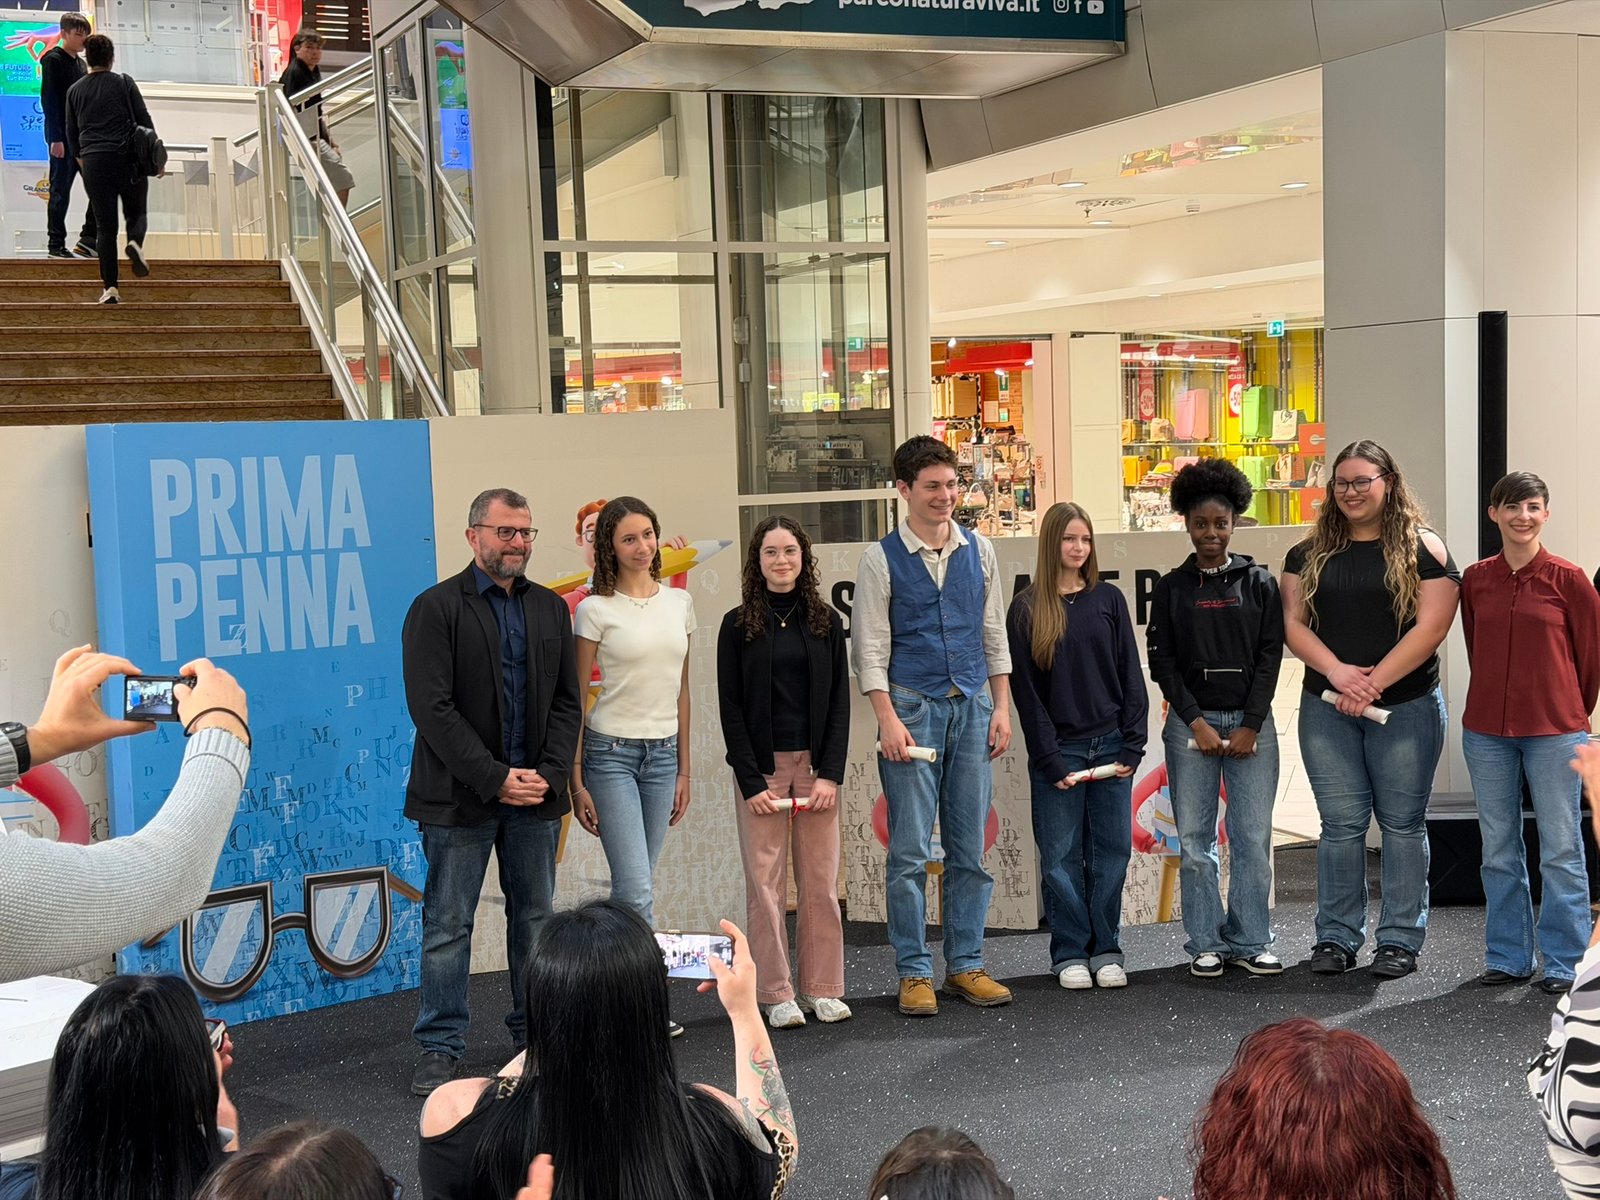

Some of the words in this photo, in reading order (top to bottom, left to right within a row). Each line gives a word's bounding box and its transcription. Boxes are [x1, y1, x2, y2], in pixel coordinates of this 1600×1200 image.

[150, 454, 371, 558] PRIMA
[155, 552, 375, 662] PENNA
[344, 685, 364, 707] P
[368, 677, 390, 700] H
[312, 726, 331, 744] M
[357, 750, 370, 764] P
[372, 737, 392, 759] U
[345, 763, 361, 783] C
[375, 757, 392, 778] N
[307, 783, 316, 794] D
[245, 786, 270, 814] M
[320, 793, 342, 816] K
[299, 848, 322, 871] W
